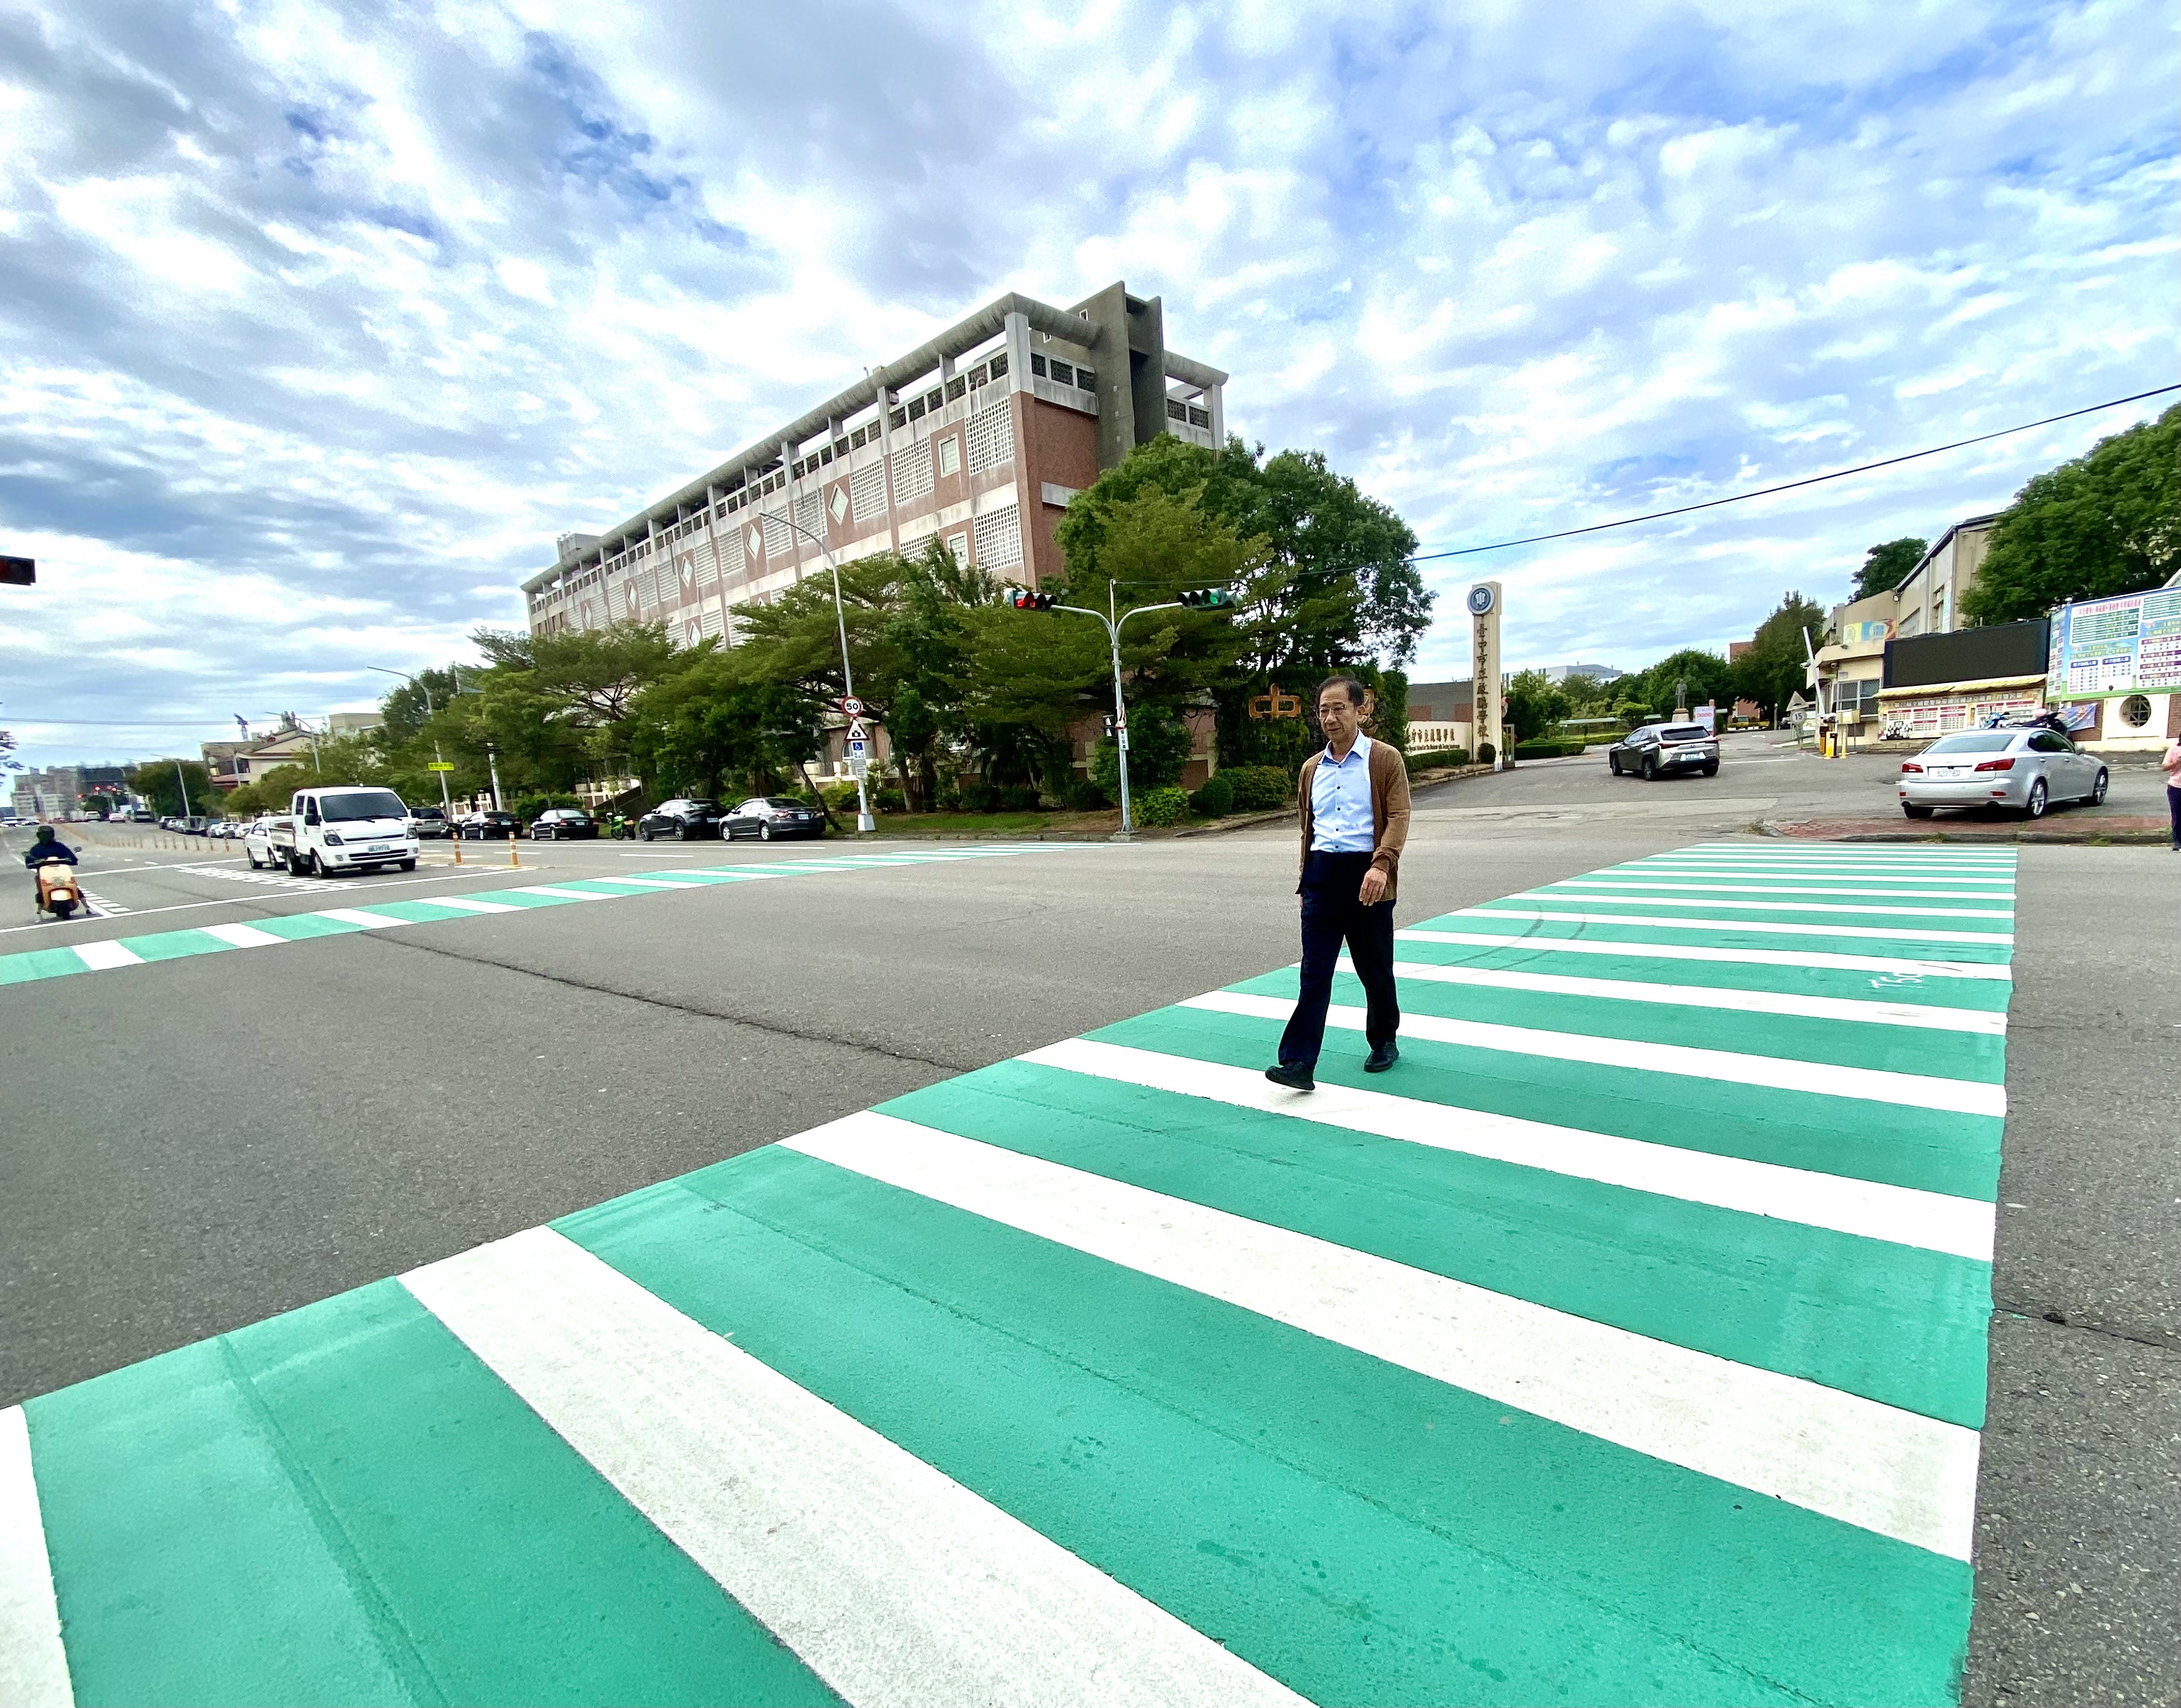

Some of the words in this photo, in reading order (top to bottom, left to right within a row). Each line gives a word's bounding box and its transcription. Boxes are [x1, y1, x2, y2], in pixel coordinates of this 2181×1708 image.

[1477, 624, 1488, 737] 臺中市立啟聰學校
[1249, 683, 1301, 719] 中
[1408, 728, 1455, 743] 中市立啟聰學校
